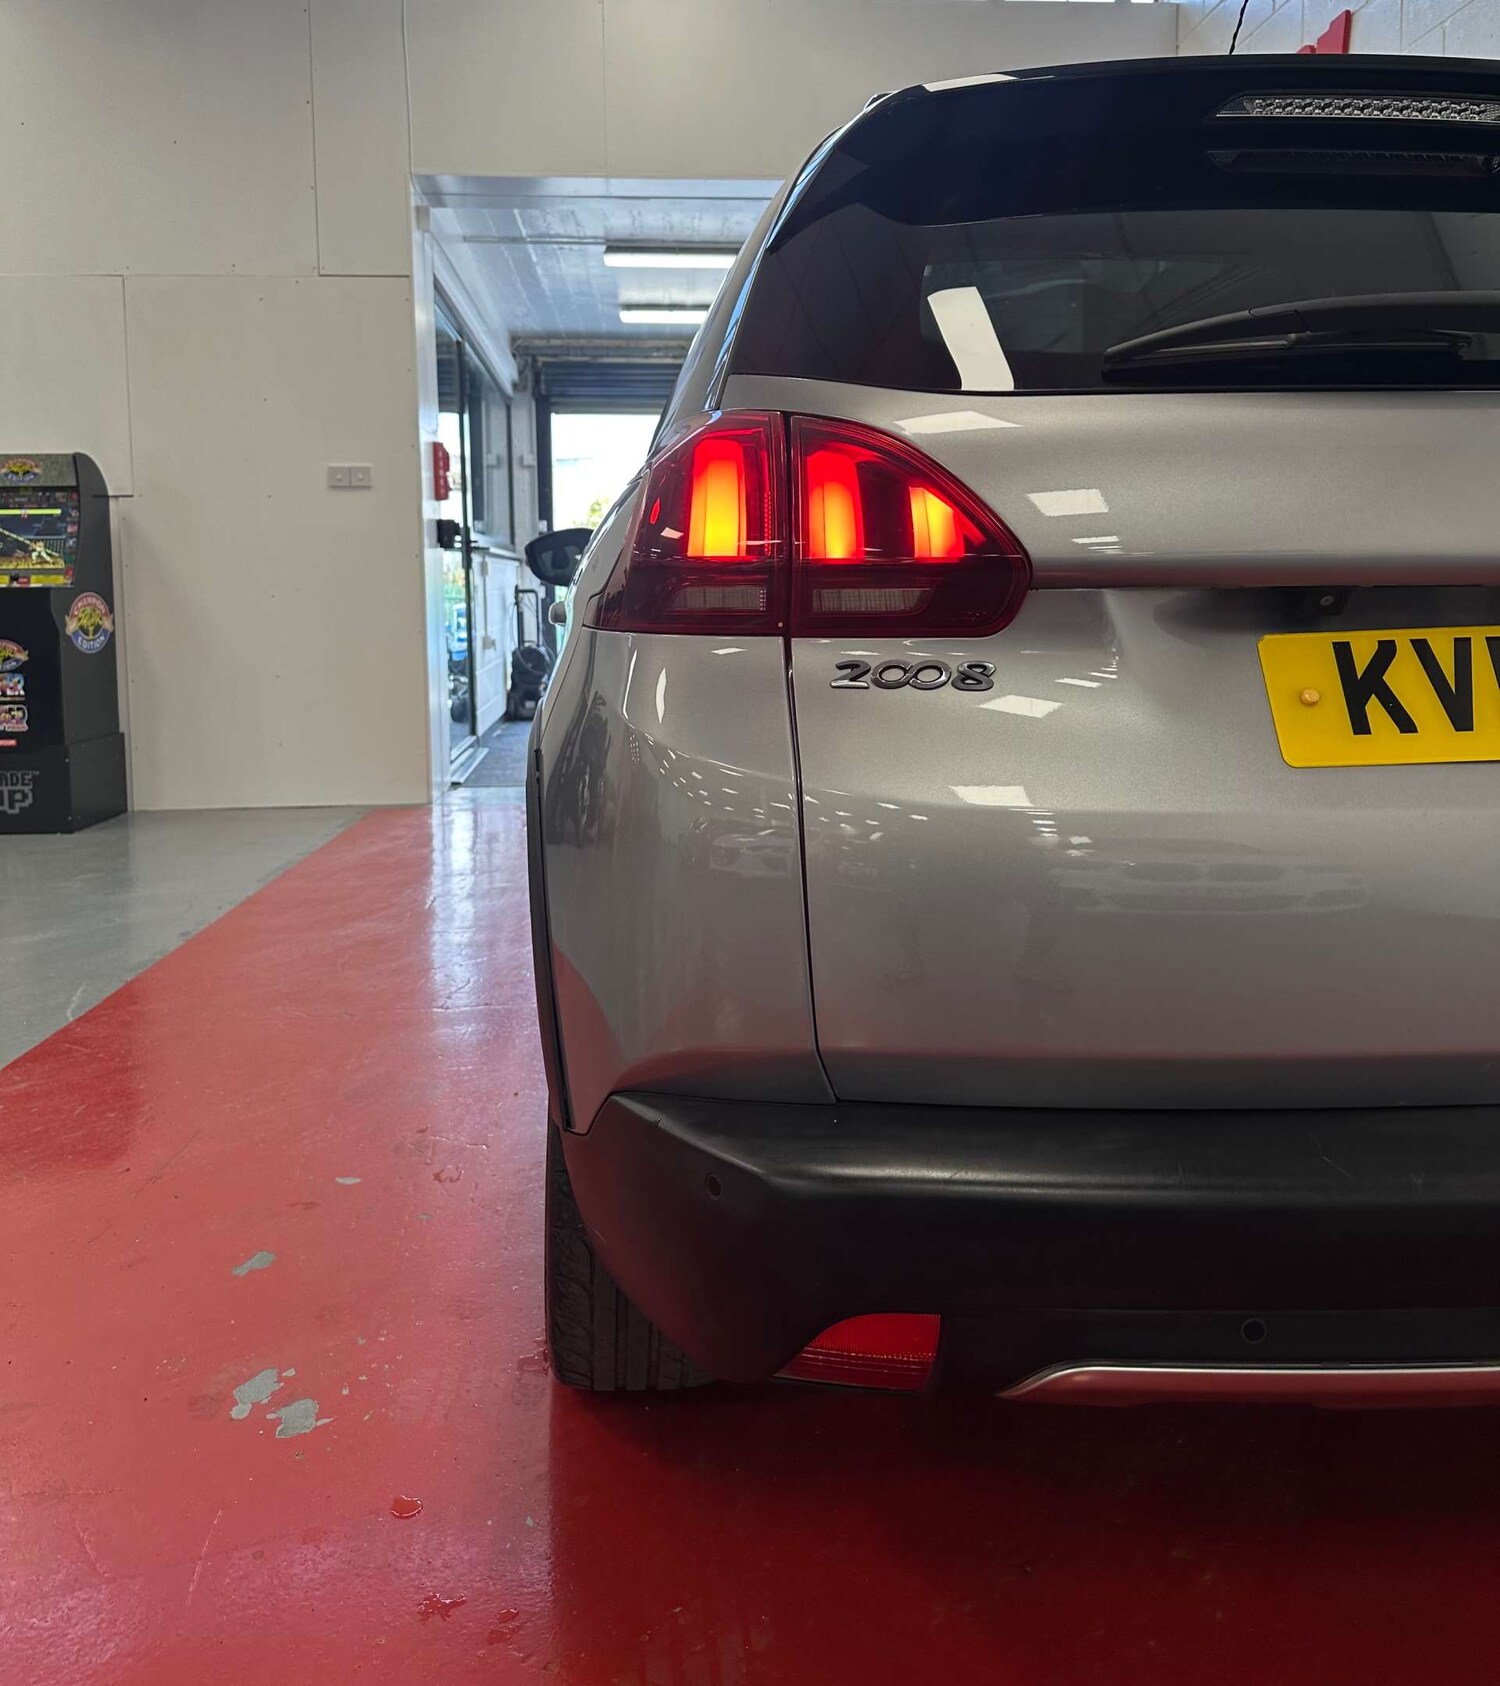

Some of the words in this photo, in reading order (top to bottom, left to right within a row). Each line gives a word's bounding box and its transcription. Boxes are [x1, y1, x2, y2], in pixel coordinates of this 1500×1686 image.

[77, 635, 105, 649] EDITION
[829, 659, 997, 692] 2008
[1331, 636, 1500, 736] KV
